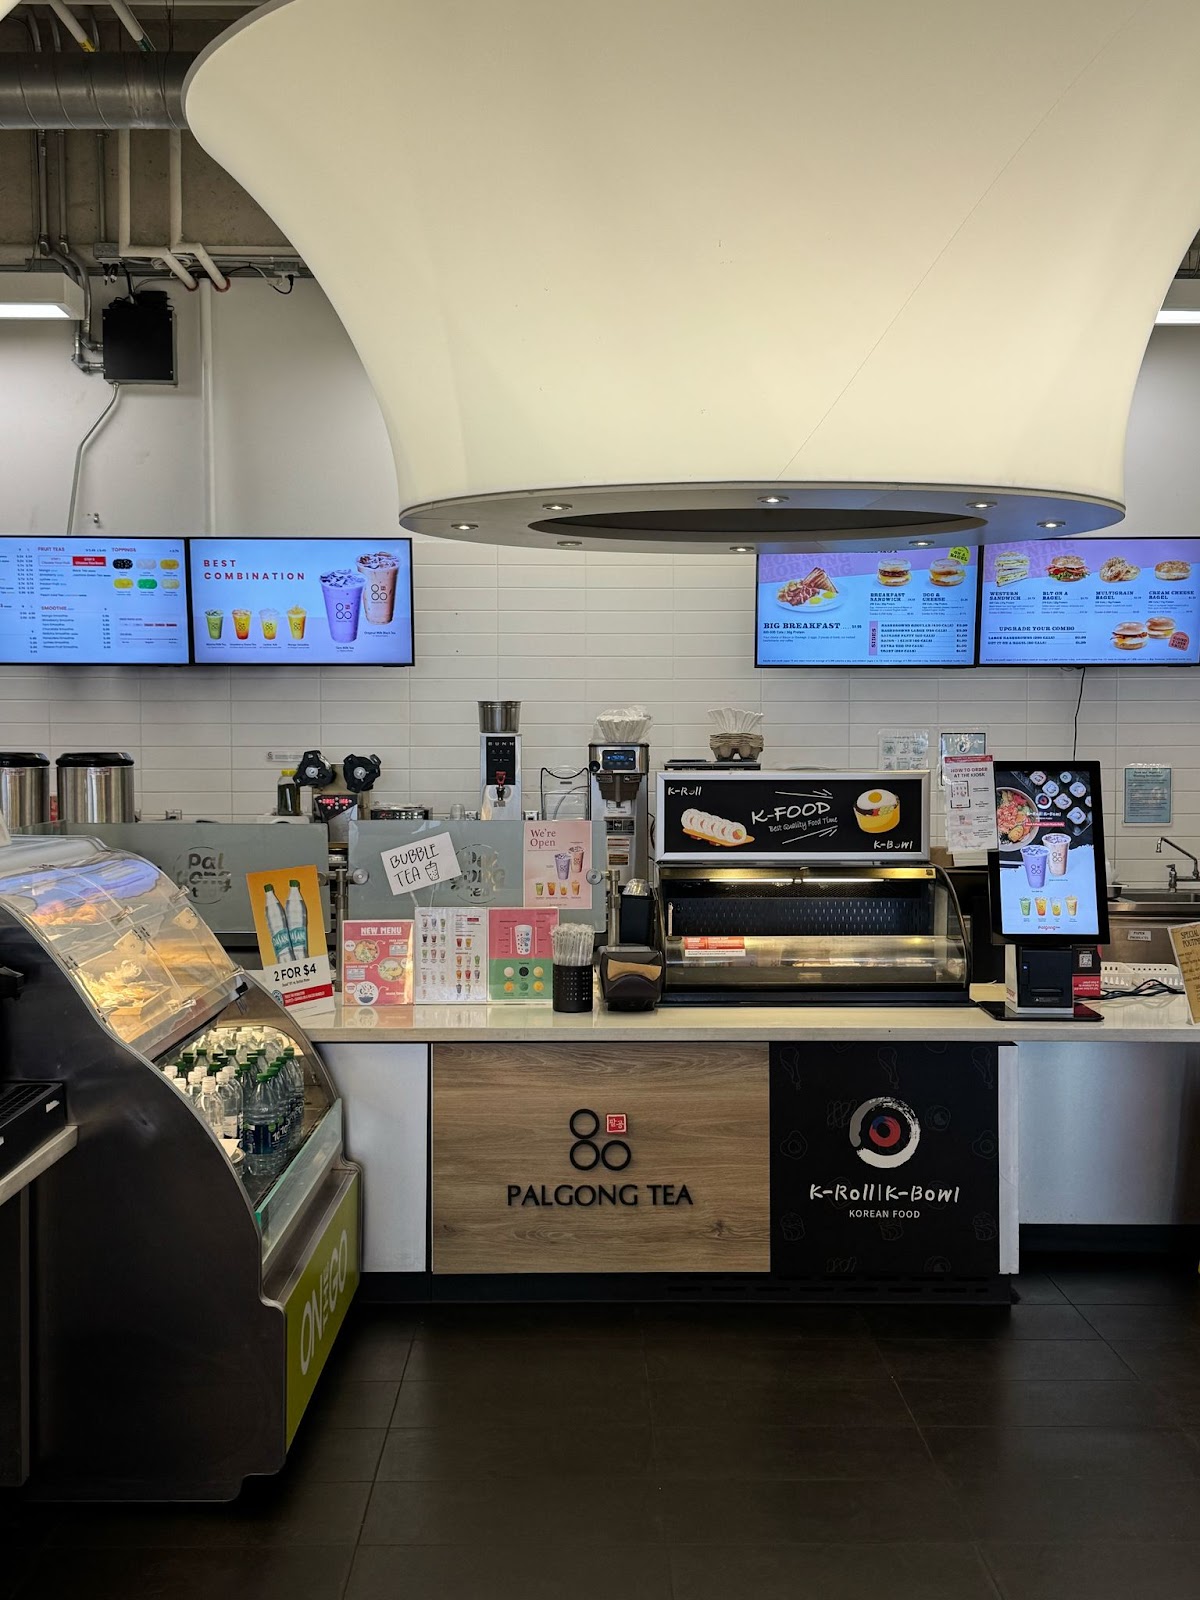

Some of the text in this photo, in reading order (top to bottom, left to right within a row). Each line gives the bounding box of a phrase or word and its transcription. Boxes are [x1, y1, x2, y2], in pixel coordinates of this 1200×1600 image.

[204, 572, 305, 580] COMBINATION
[751, 802, 831, 824] K-FOOD
[530, 829, 556, 837] We're
[768, 816, 838, 833] Best Quality Food Time
[530, 838, 556, 849] Open
[390, 844, 440, 868] BUBBLE
[394, 870, 420, 887] TEA
[274, 963, 316, 981] 2 FOR $4
[507, 1184, 694, 1206] PALGONG TEA
[849, 1210, 920, 1218] KOREAN FOOD
[329, 1229, 348, 1312] GO
